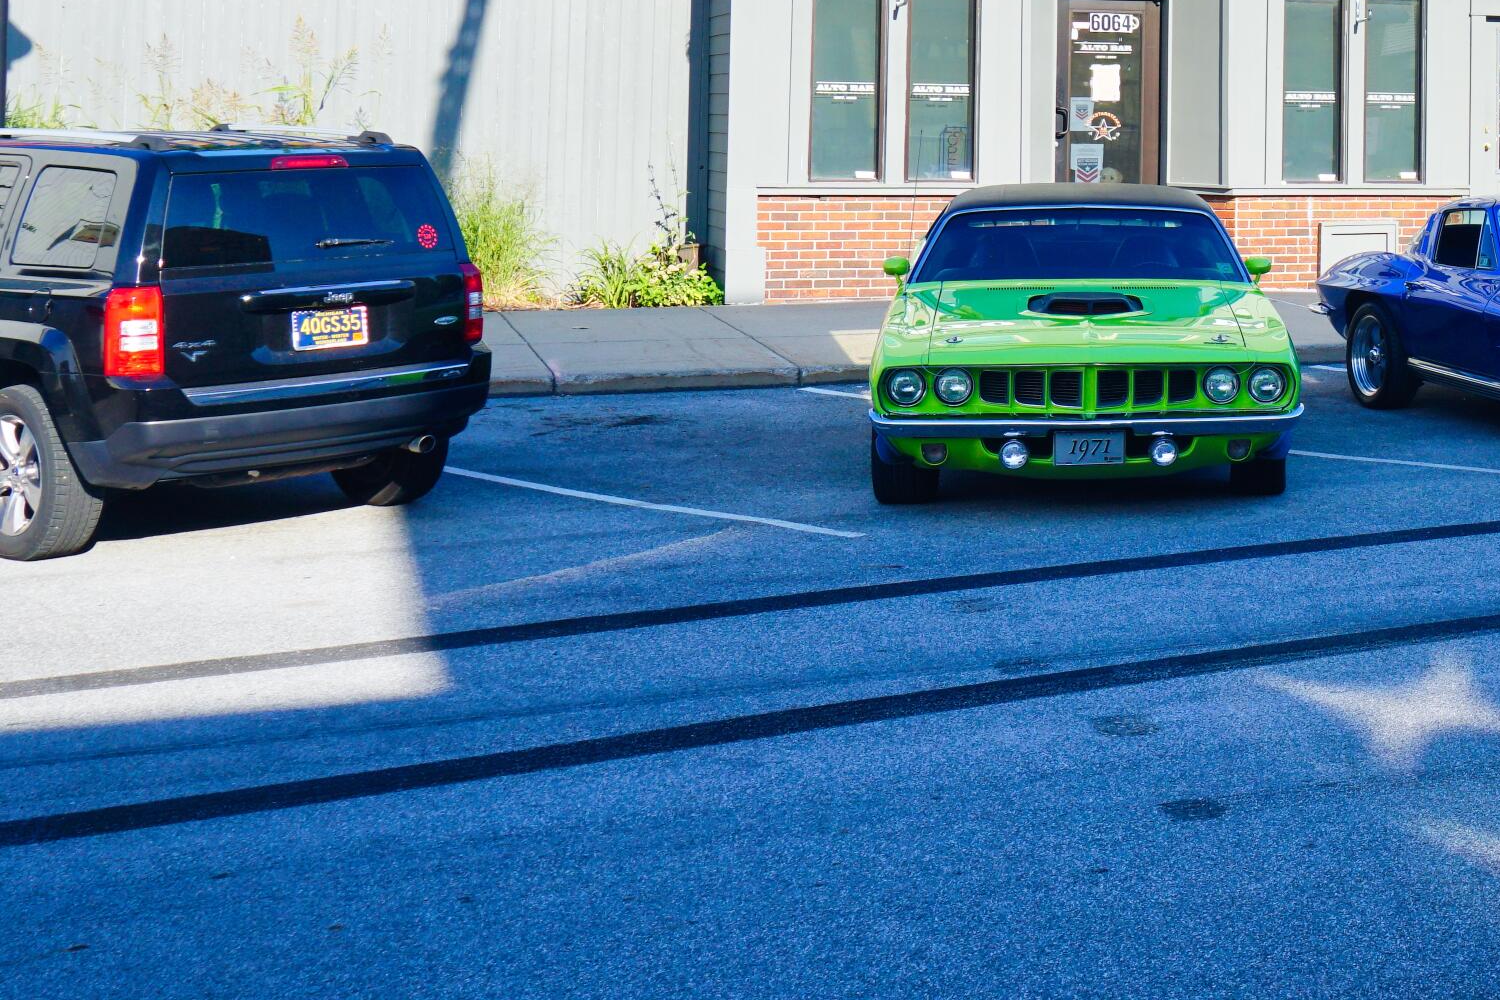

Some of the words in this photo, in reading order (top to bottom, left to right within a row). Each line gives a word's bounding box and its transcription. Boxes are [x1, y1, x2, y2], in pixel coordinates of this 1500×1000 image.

[1091, 13, 1132, 32] 6064
[1079, 44, 1109, 52] ALTO
[1109, 44, 1133, 52] BAR
[815, 83, 848, 92] ALTO
[849, 84, 875, 92] BAR
[912, 85, 944, 93] ALTO
[944, 86, 970, 94] BAR
[1284, 93, 1313, 101] ALTO
[1313, 93, 1336, 101] BAR
[323, 291, 354, 304] Jeep
[1068, 439, 1113, 462] 1971
